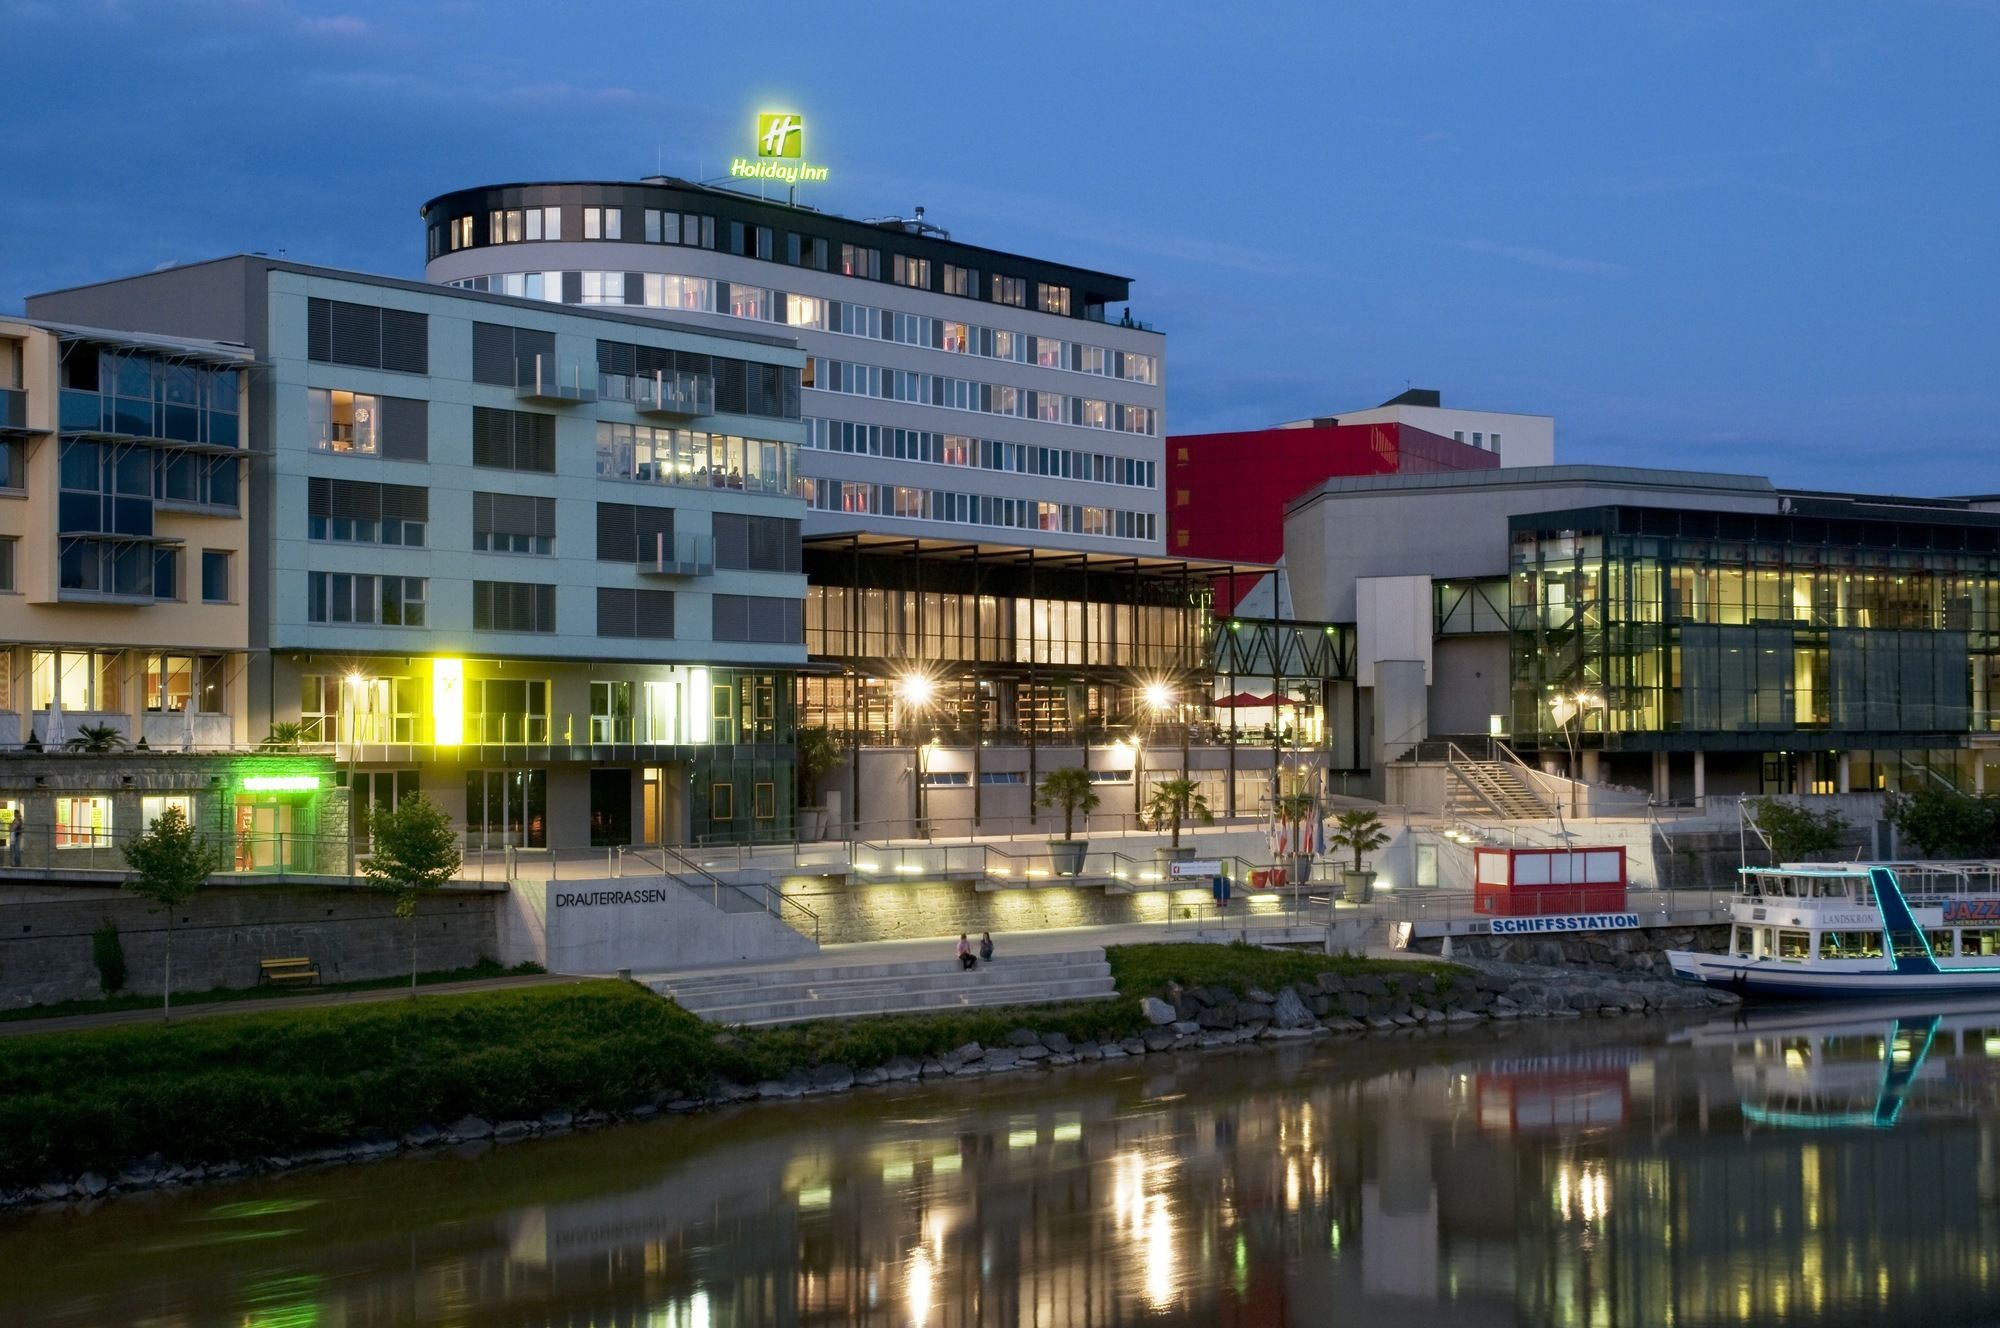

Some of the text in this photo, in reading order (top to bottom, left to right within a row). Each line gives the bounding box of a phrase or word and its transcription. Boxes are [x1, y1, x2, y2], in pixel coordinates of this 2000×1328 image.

[731, 159, 829, 183] Holiday Inn
[556, 889, 666, 907] DRAUTERRASSEN
[1943, 900, 2000, 920] JAZZ
[1492, 915, 1639, 933] SCHIFFSSTATION
[1822, 914, 1874, 925] LANDSKRON
